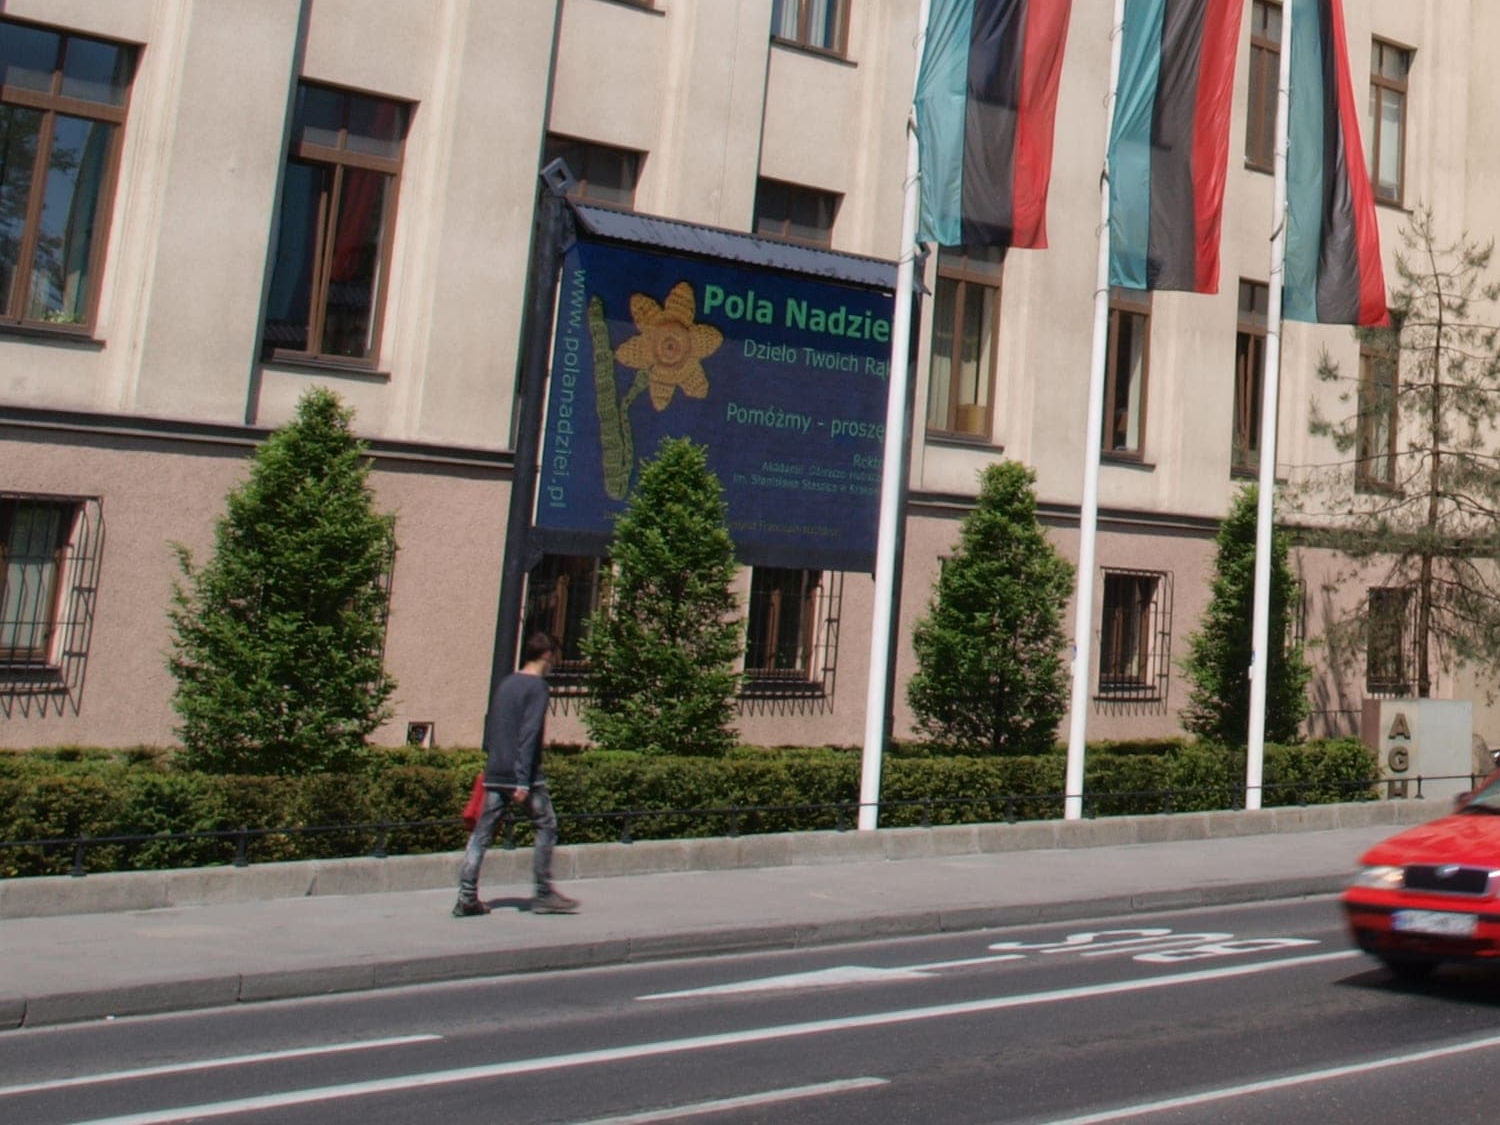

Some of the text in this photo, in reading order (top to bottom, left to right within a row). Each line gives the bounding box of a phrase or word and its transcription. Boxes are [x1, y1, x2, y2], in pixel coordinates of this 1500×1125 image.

[703, 285, 892, 343] Pola Nadzie
[548, 269, 587, 508] www.polanadziei.pl
[803, 347, 859, 373] Twoich
[726, 402, 812, 434] Pomóżmy
[1387, 713, 1411, 800] AGH
